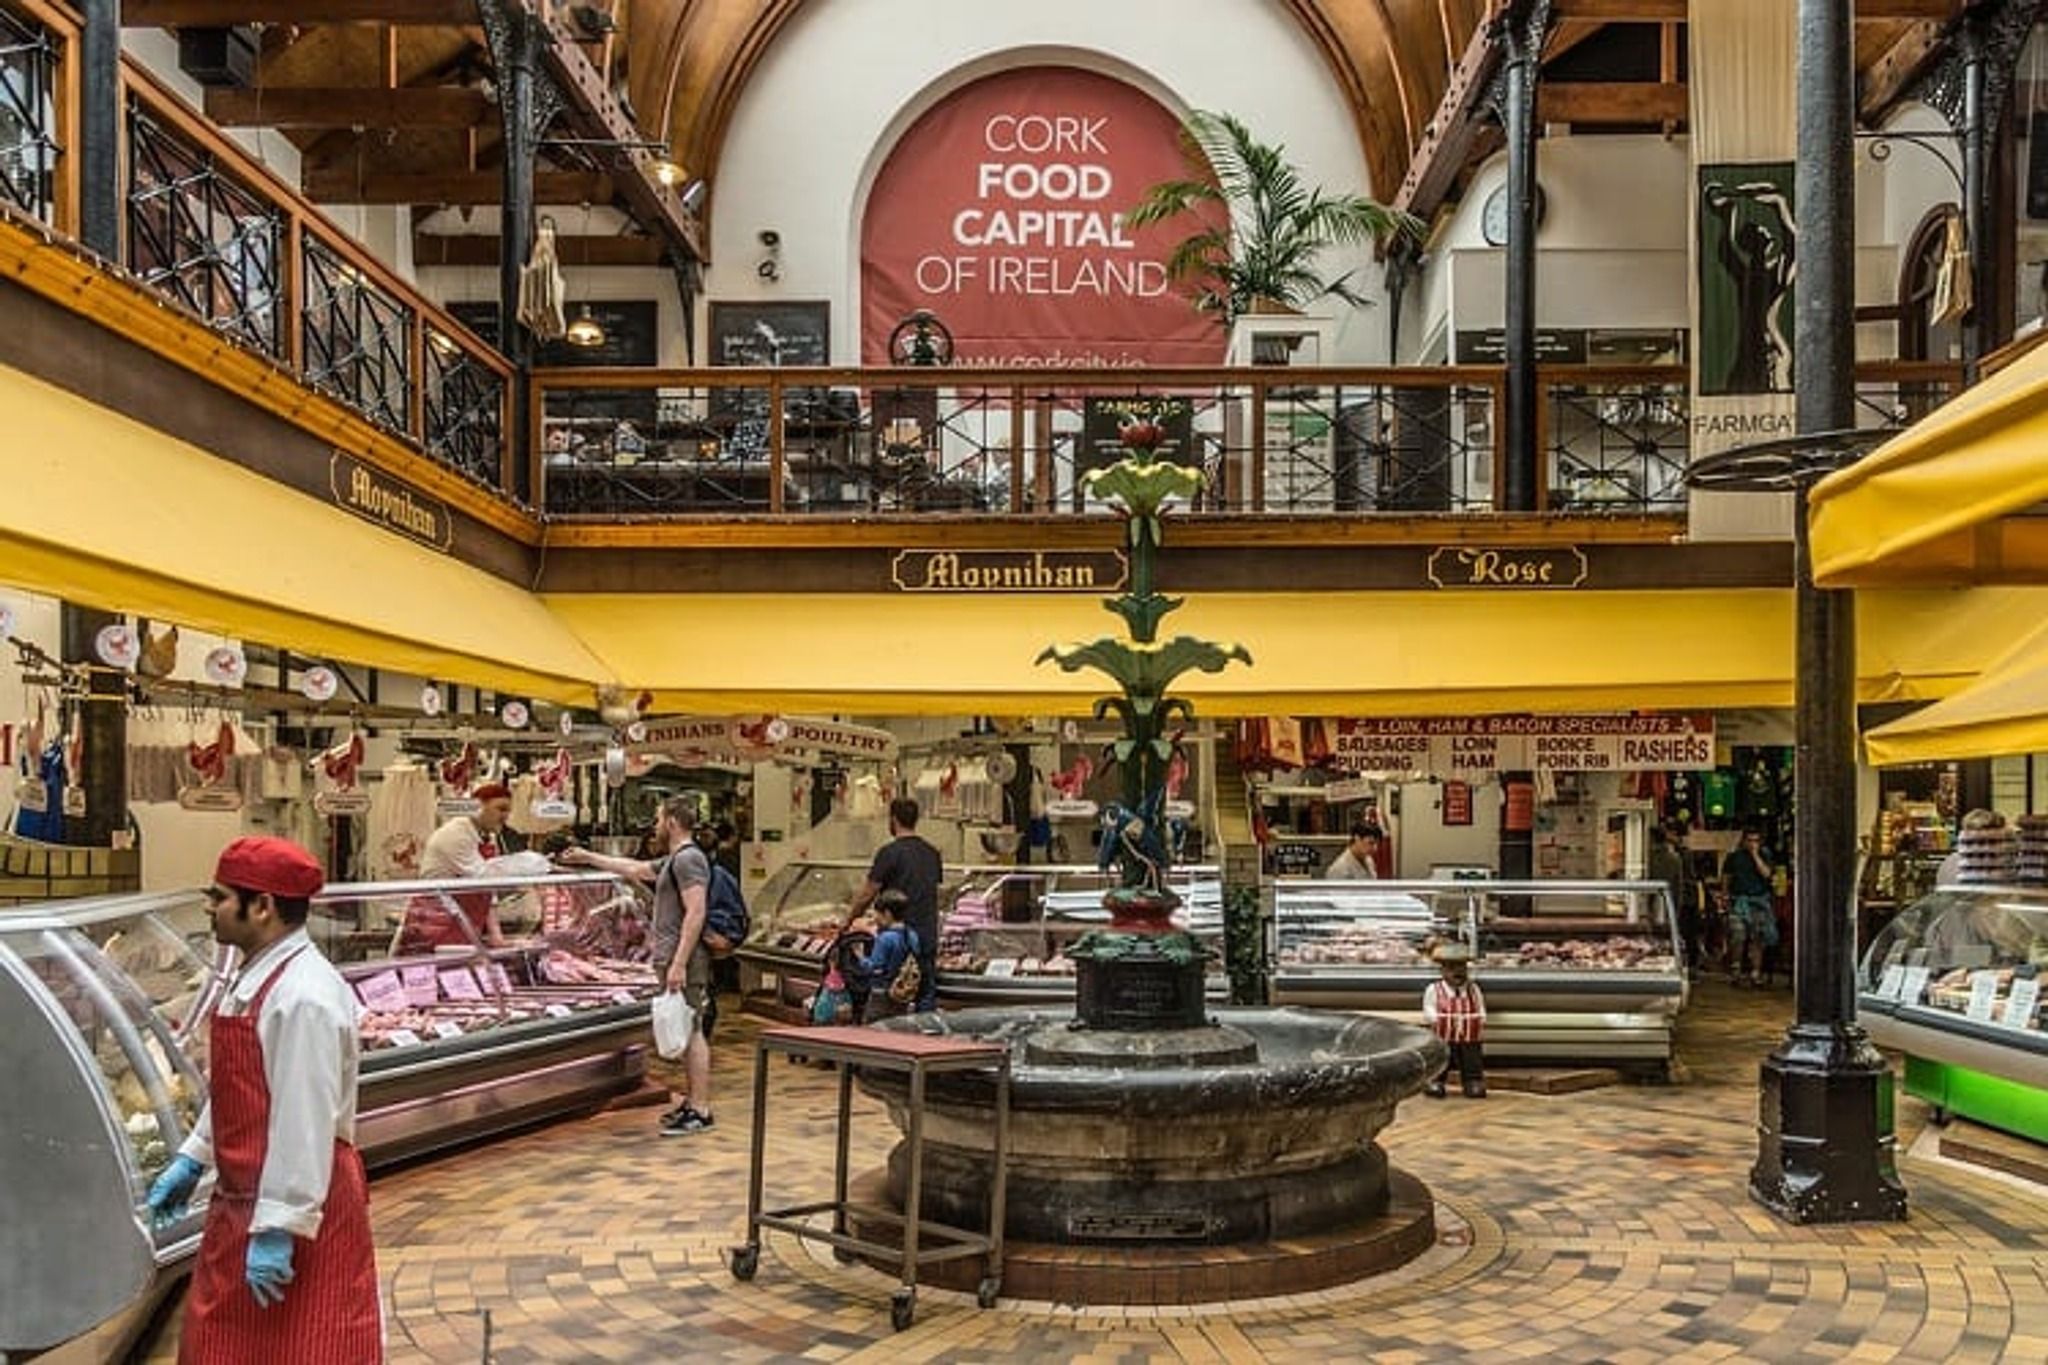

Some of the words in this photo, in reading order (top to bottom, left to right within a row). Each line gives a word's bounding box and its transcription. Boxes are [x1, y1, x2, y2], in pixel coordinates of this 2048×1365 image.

[985, 115, 1109, 154] CORK
[979, 163, 1112, 200] FOOD
[953, 210, 1135, 248] CAPITAL
[916, 256, 978, 294] OF
[989, 258, 1168, 297] IRELAND
[1693, 413, 1794, 434] FARMGA
[350, 465, 436, 540] Moynihan
[926, 552, 1094, 588] Moynihan
[1458, 548, 1553, 582] Rose
[1428, 718, 1468, 734] HAM
[1472, 718, 1485, 733] &
[1489, 717, 1551, 733] BACON
[1556, 717, 1670, 733] SPECIALISTS
[792, 726, 890, 751] POULTRY
[1337, 736, 1428, 752] SAUSAGES
[1452, 736, 1497, 750] LOIN
[1537, 737, 1595, 751] BODICE
[1337, 755, 1413, 770] PUDDING
[1452, 754, 1495, 769] HAM
[1537, 754, 1581, 769] PORK
[1584, 754, 1609, 768] RIB
[1624, 739, 1708, 763] RASHERS
